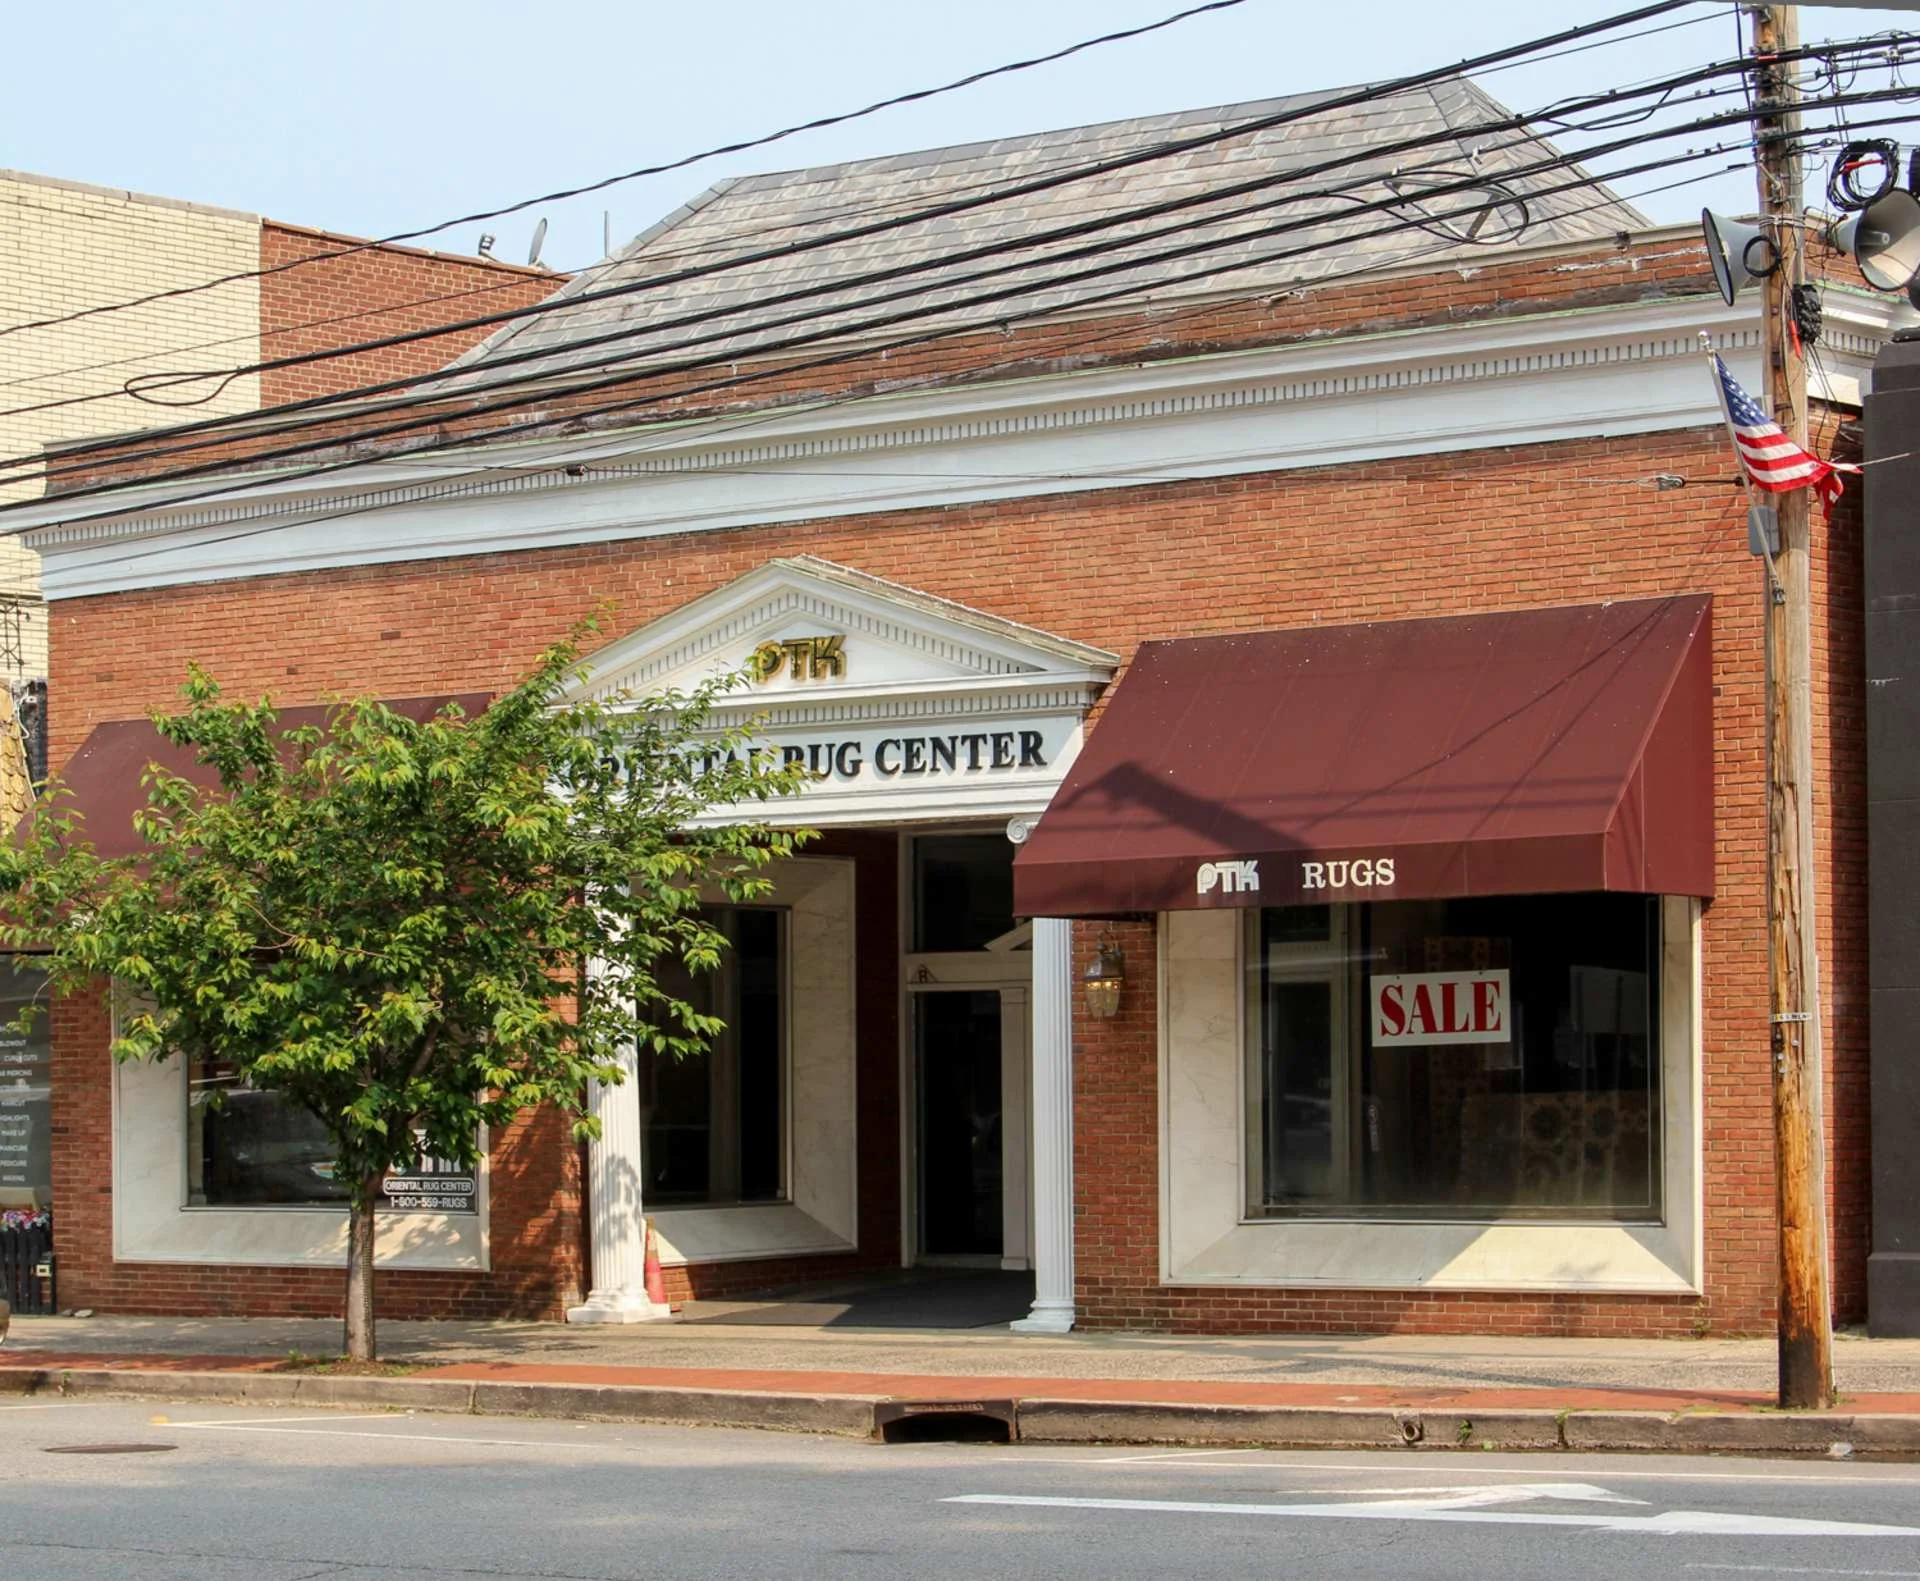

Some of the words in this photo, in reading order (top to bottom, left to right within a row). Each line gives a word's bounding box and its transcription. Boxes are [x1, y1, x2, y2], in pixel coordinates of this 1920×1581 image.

[780, 740, 863, 780] RUG
[875, 730, 1048, 775] CENTER
[1197, 860, 1260, 894] PTK
[1302, 858, 1396, 889] RUGS
[1380, 980, 1502, 1037] SALE
[386, 1181, 421, 1191] ORIENTAL
[424, 1181, 439, 1191] RUG
[441, 1181, 471, 1191] CENTER
